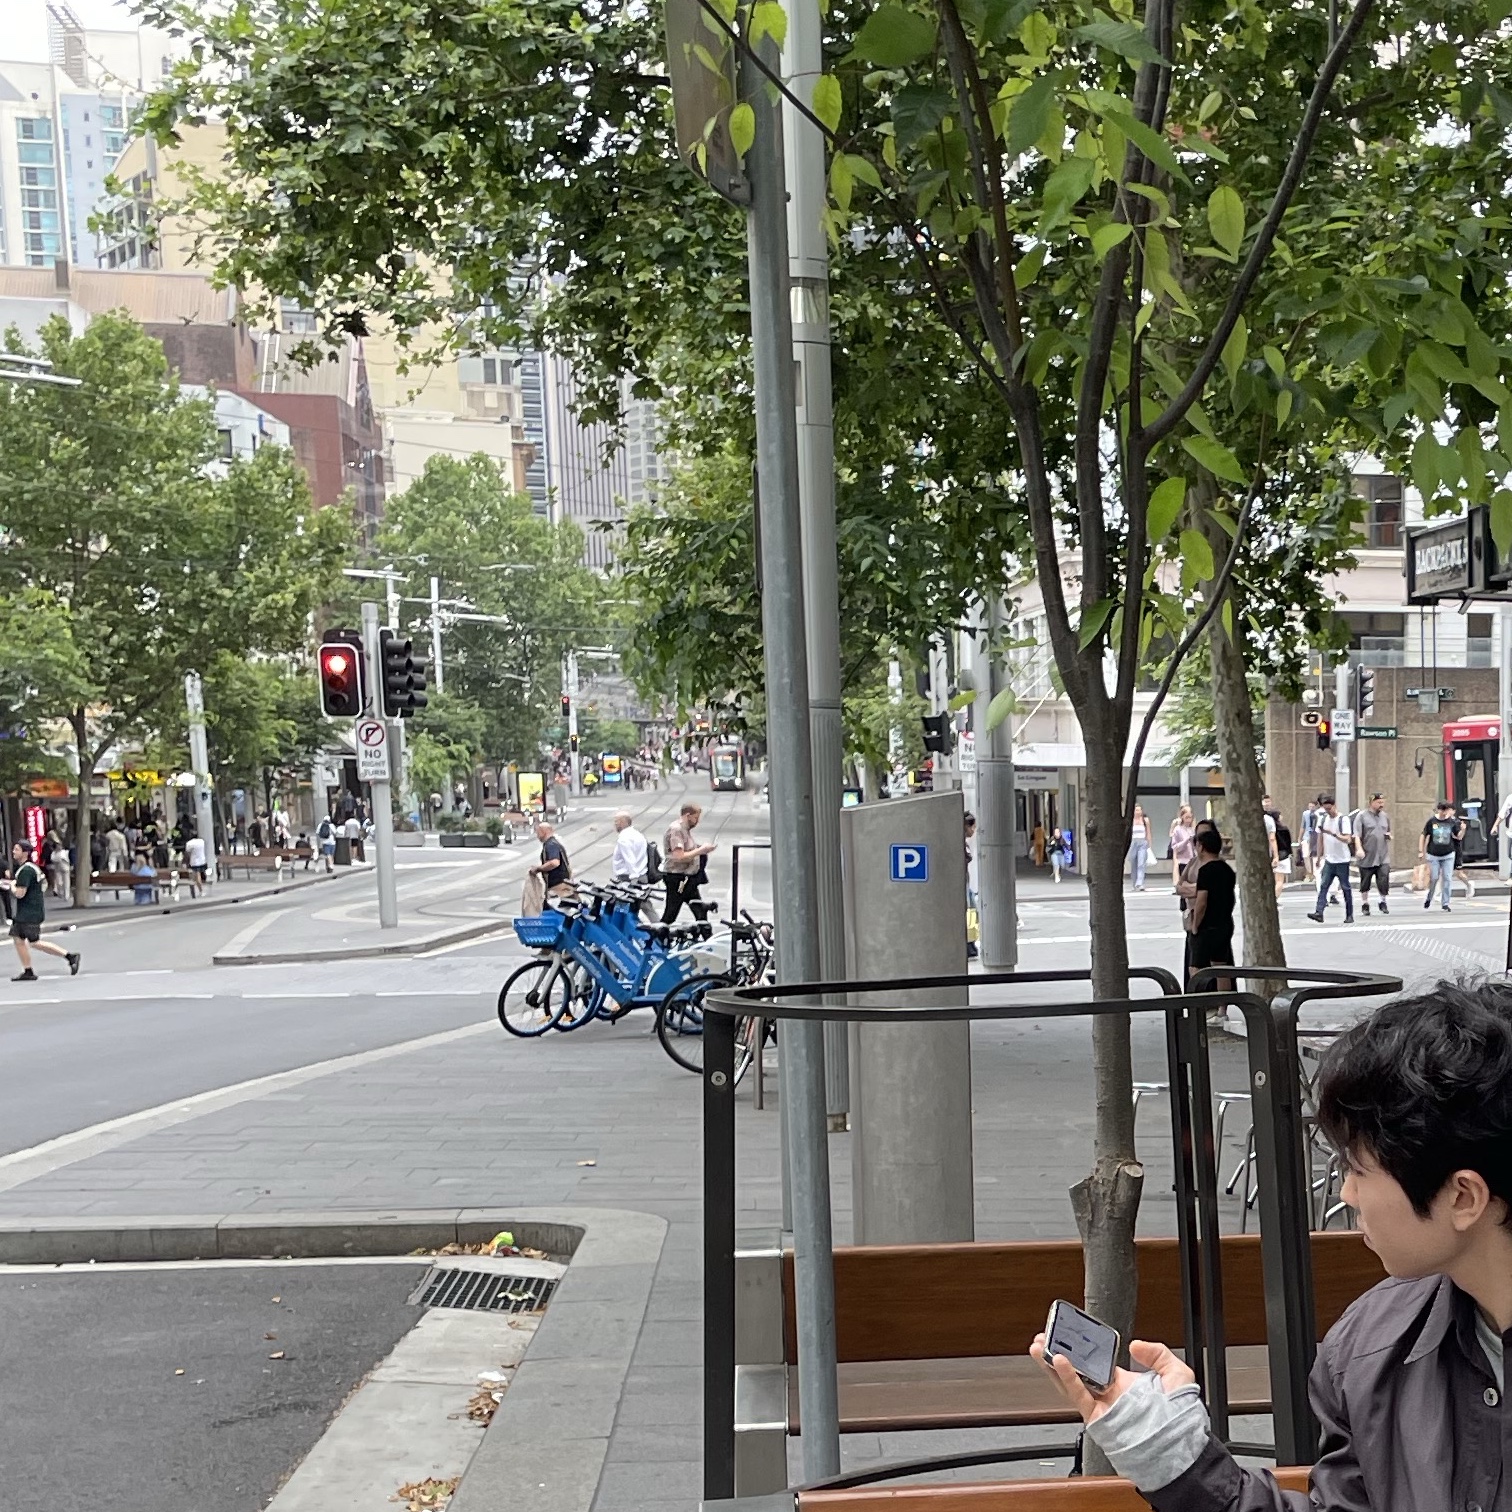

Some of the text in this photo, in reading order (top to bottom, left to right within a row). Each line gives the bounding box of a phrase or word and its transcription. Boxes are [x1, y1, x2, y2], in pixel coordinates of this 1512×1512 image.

[1334, 712, 1351, 720] ONE
[1333, 721, 1352, 730] WAY
[964, 743, 975, 752] N
[364, 749, 382, 759] NO
[898, 848, 921, 878] P
